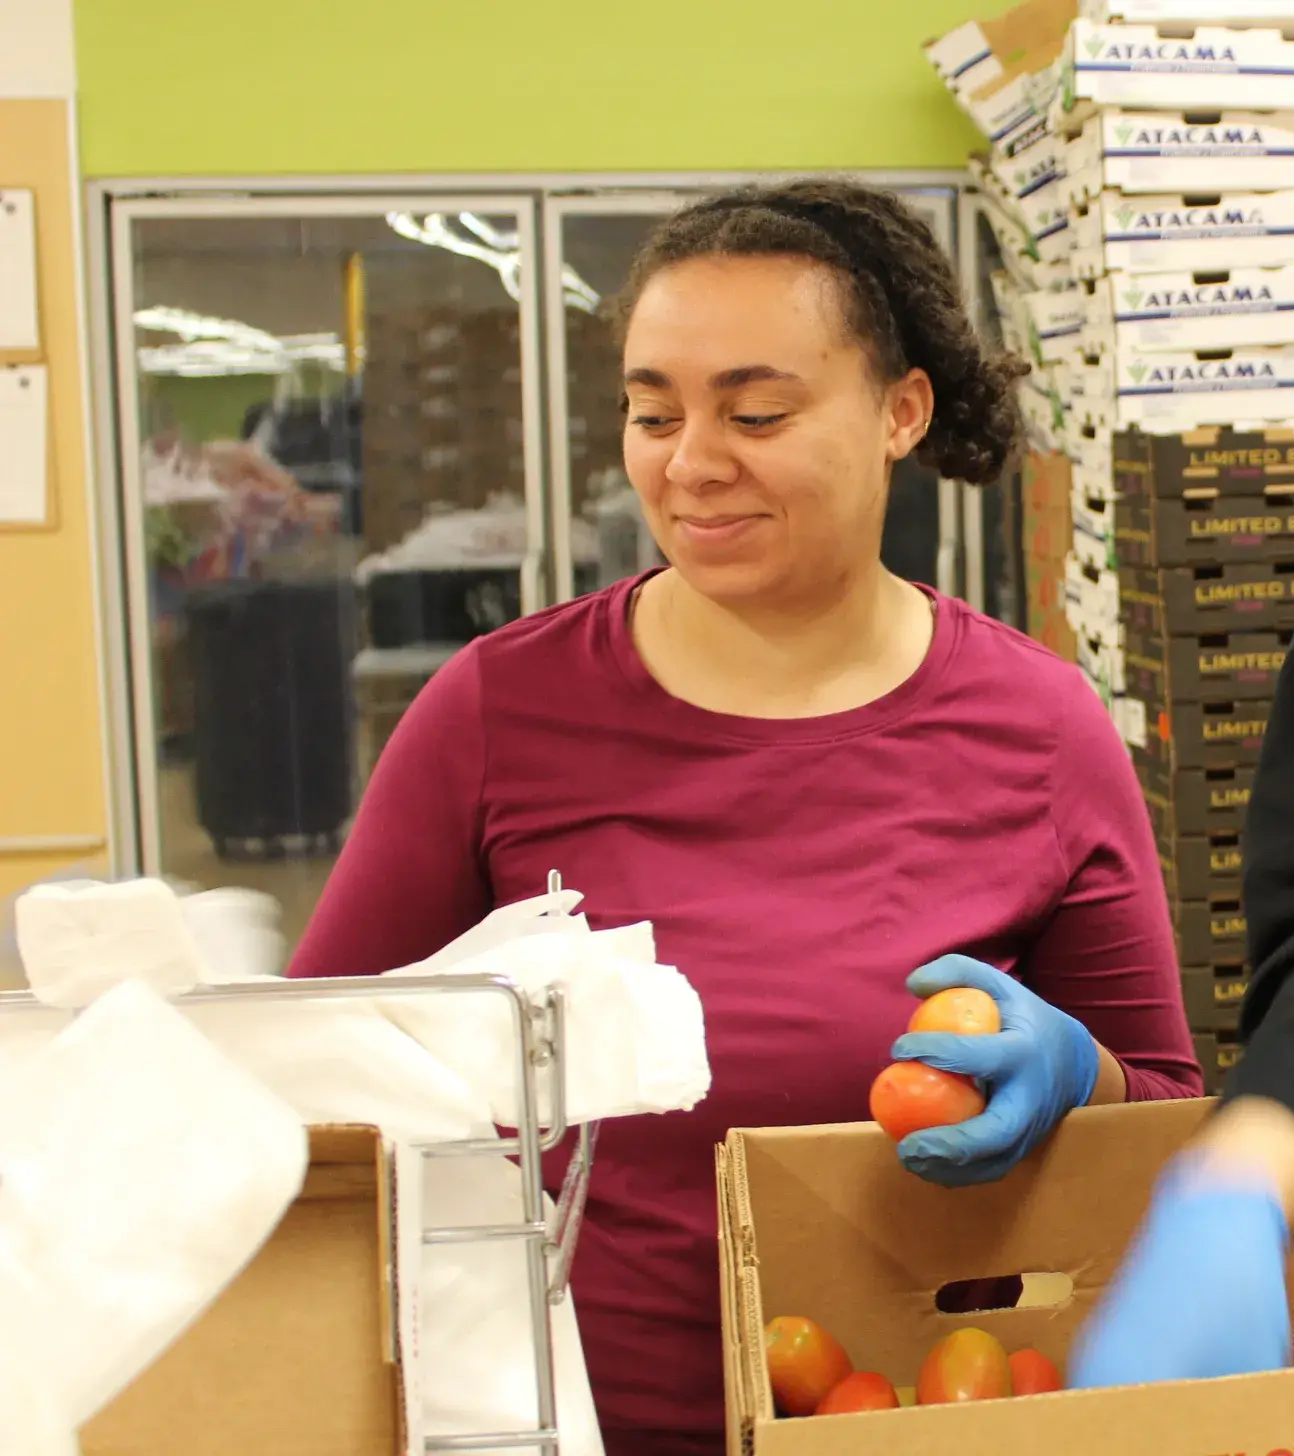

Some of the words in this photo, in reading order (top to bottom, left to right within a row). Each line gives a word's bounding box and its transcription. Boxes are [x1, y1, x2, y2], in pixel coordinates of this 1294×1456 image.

[1105, 43, 1237, 62] ATACAMA
[1136, 126, 1265, 145] ATACAMA
[1133, 209, 1265, 229] ATACAMA
[1145, 285, 1274, 308] ATACAMA
[1147, 362, 1276, 382] ATACAMA
[1190, 449, 1280, 467] LIMITED
[1191, 516, 1281, 536] LIMITED
[1195, 581, 1284, 603] LIMITED
